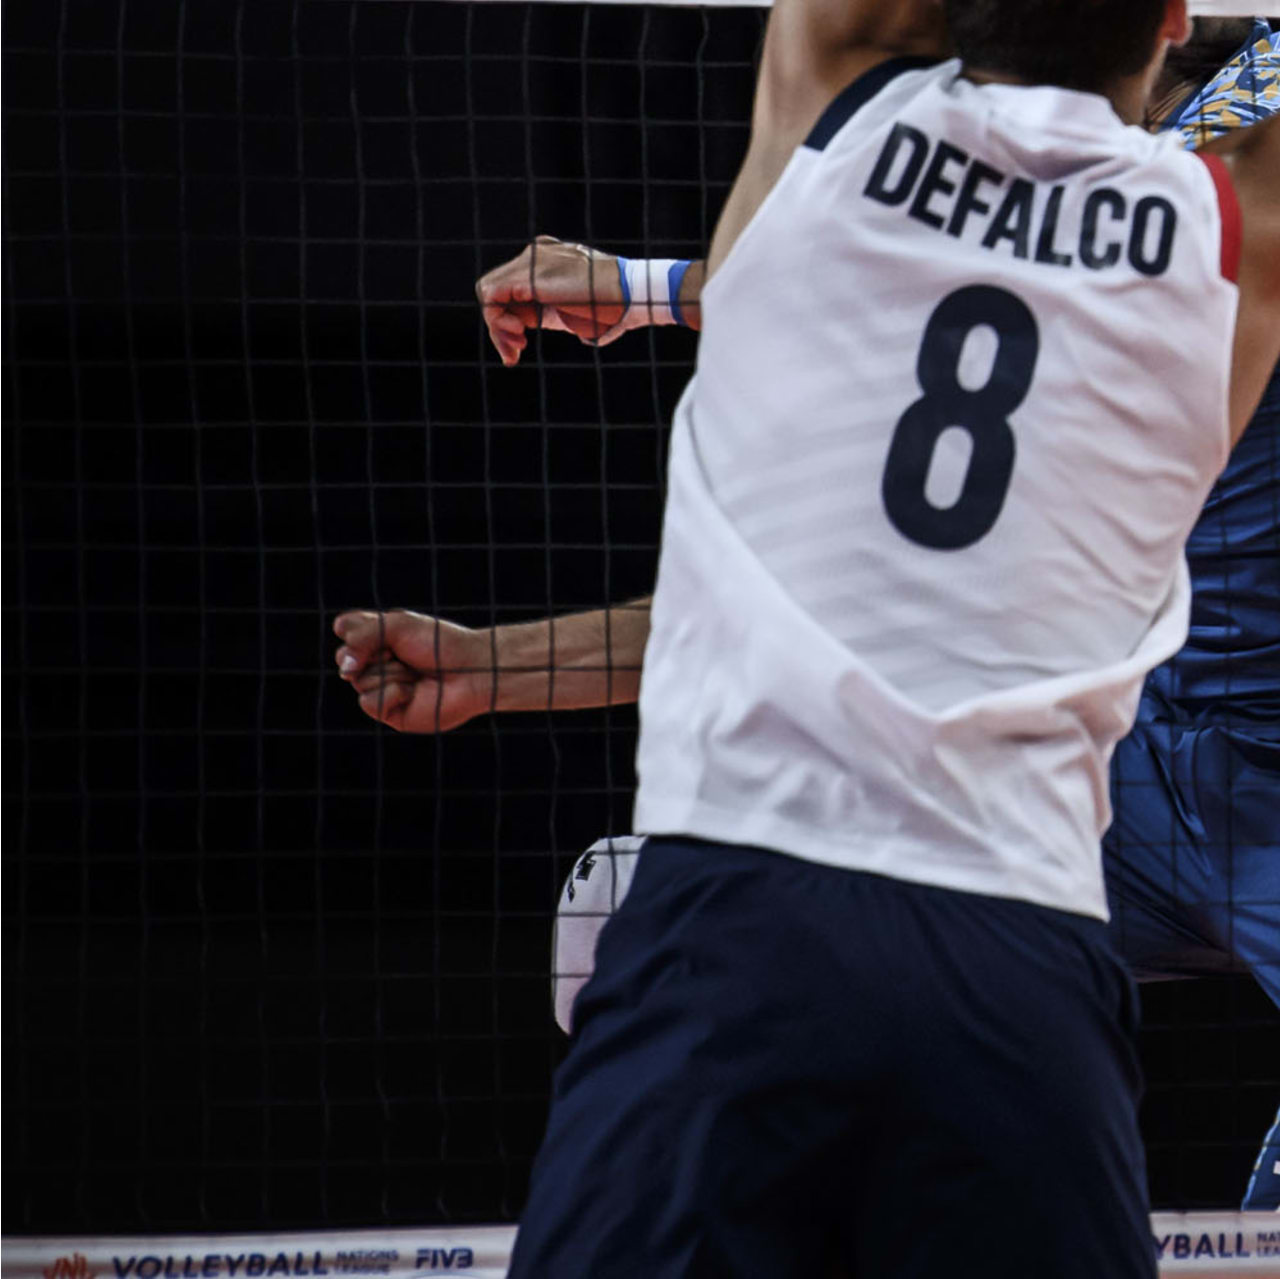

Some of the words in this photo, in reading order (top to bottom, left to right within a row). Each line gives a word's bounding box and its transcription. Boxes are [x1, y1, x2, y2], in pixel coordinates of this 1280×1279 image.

[862, 122, 1178, 277] DEFALCO
[882, 283, 1040, 553] 8
[111, 1251, 329, 1279] VOLLEYBALL
[415, 1247, 474, 1269] FIVB
